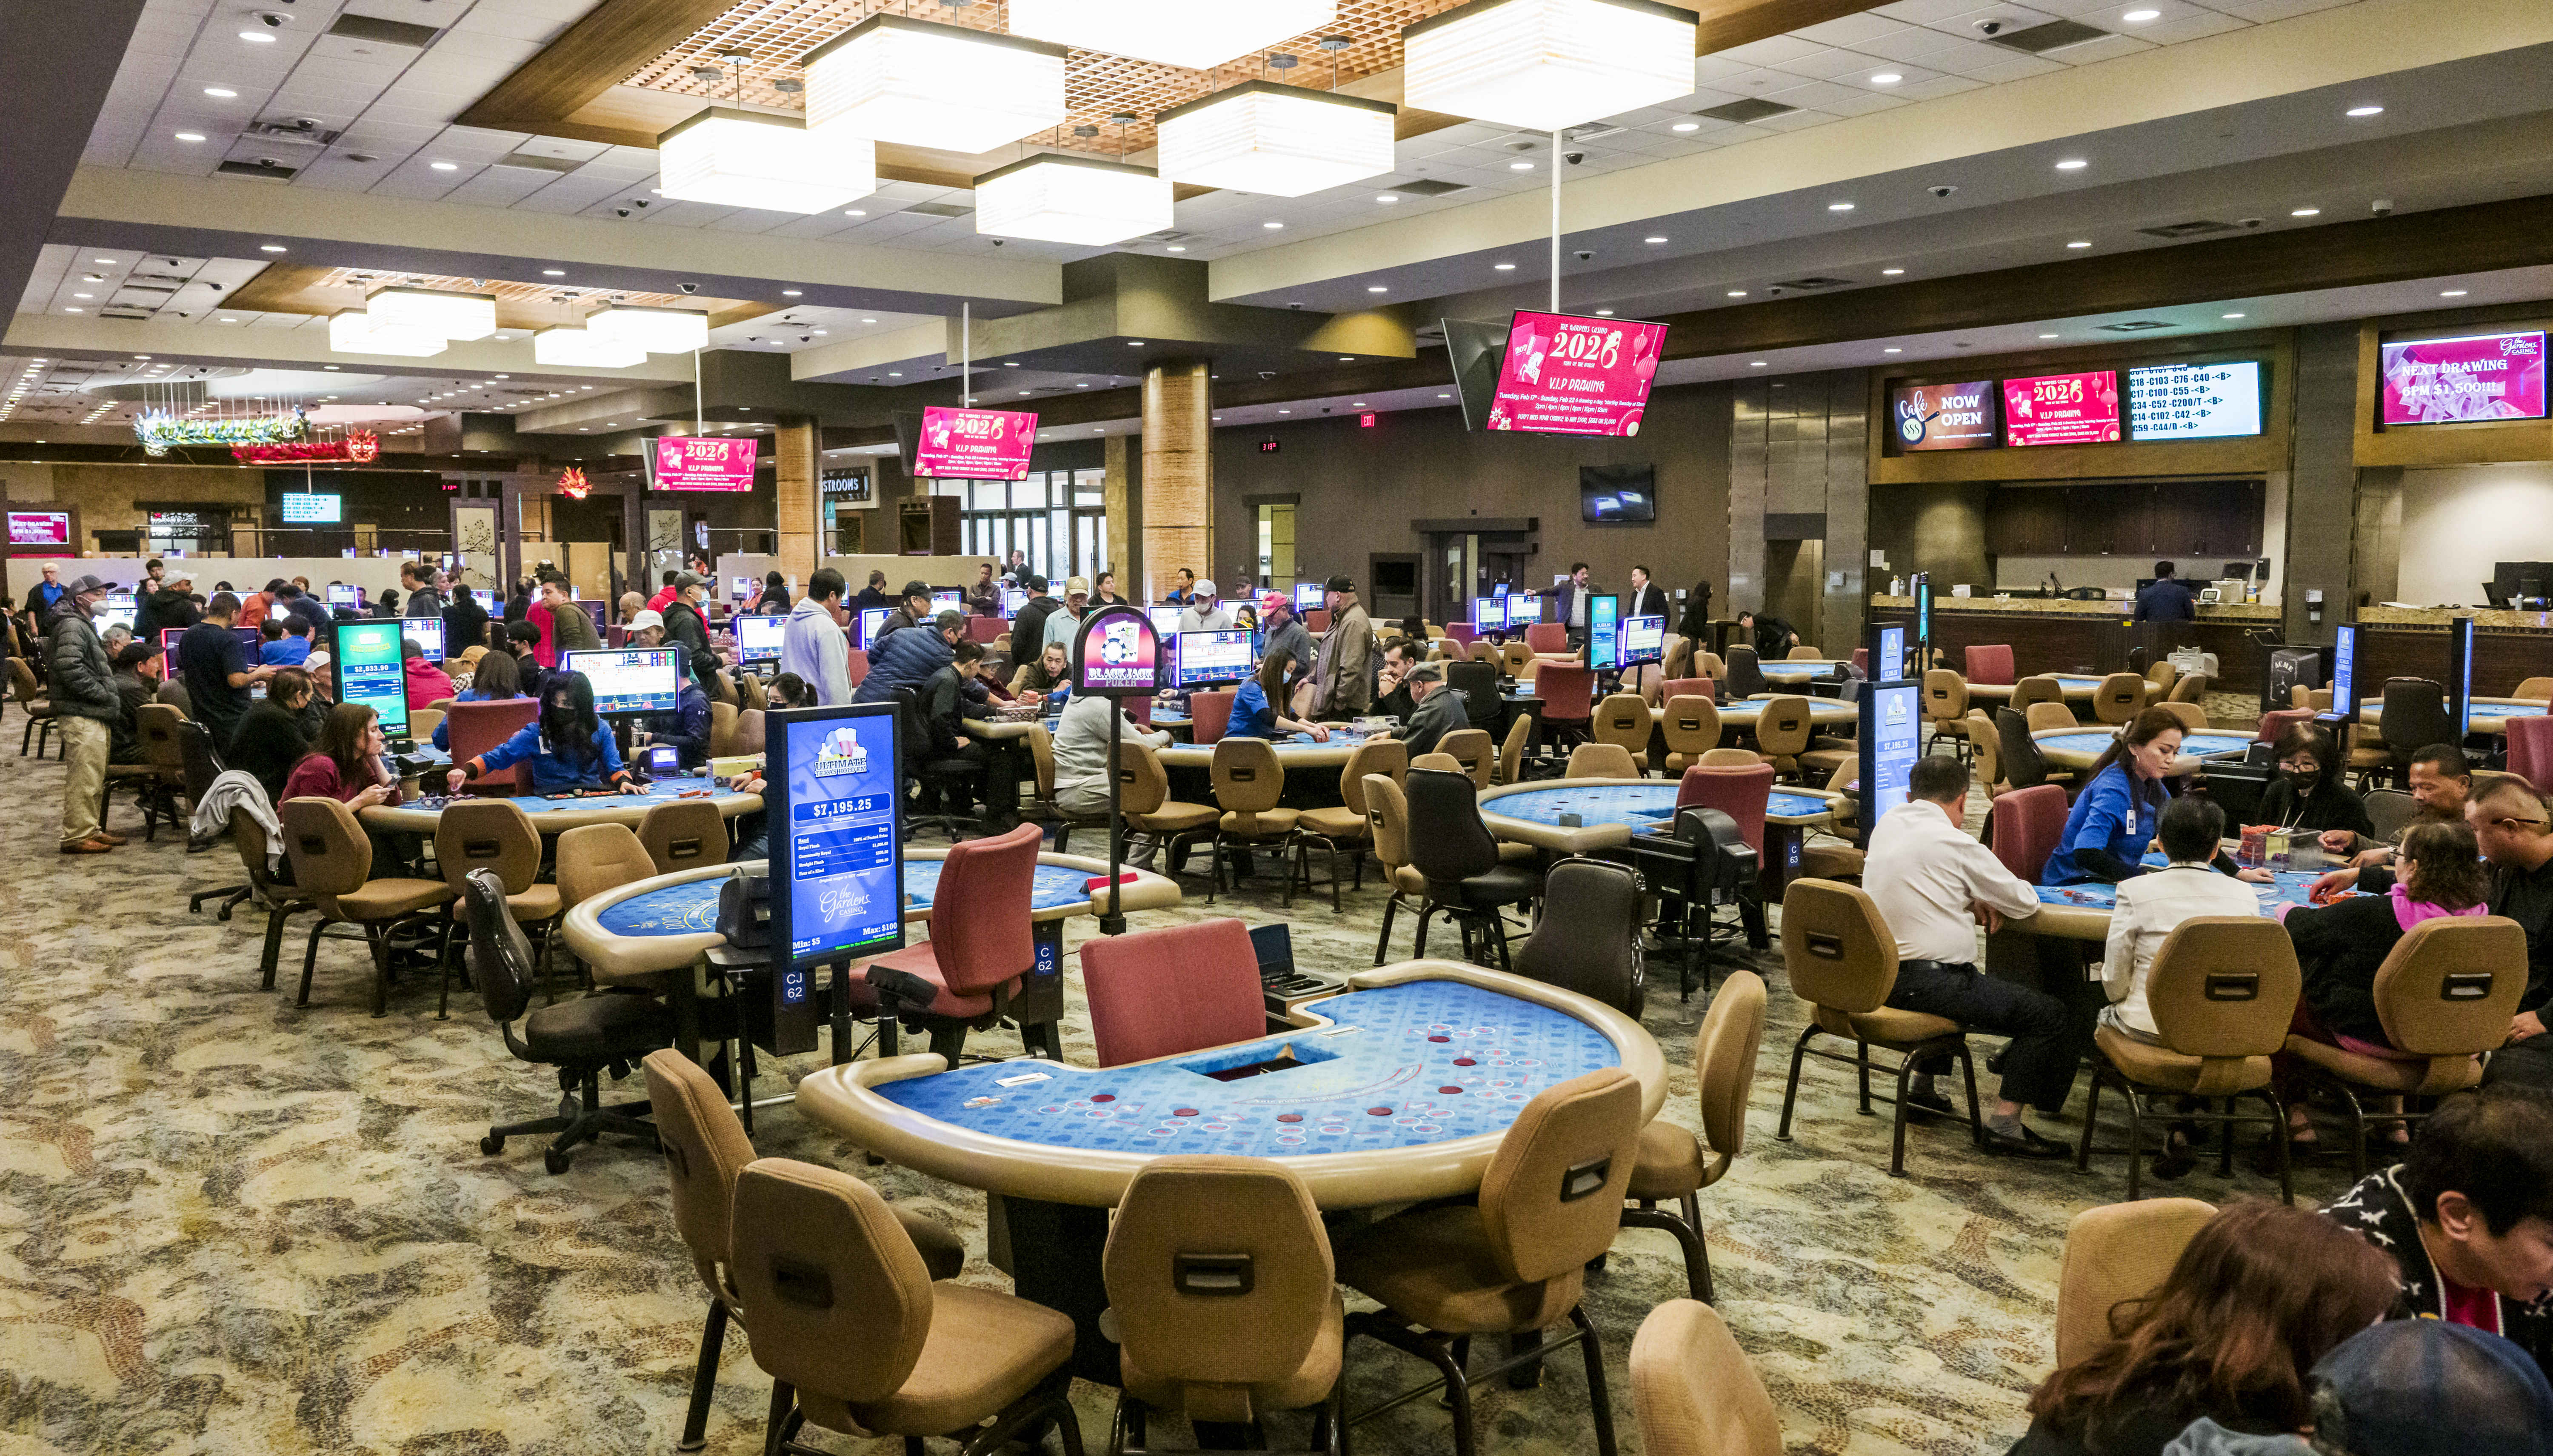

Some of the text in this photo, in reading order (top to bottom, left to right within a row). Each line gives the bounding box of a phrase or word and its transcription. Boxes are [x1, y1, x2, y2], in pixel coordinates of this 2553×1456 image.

[1569, 324, 1590, 332] GARDENS
[2514, 336, 2523, 344] the
[1549, 330, 1622, 369] 2026
[2500, 338, 2538, 356] Gardens
[2402, 359, 2508, 377] NEXT DRAWING
[1549, 377, 1605, 392] V.I.P DRAWING
[2130, 378, 2145, 387] C18
[2146, 377, 2169, 385] -C103
[2171, 375, 2189, 384] -C76
[2191, 373, 2210, 382] -C40
[1499, 392, 1519, 400] Tuesday,
[2034, 379, 2083, 403] 2026
[2131, 390, 2144, 398] C17
[2145, 388, 2168, 397] -C100
[2170, 387, 2189, 396] -C55
[2402, 385, 2430, 397] 6PM
[1900, 391, 1928, 422] Café
[1941, 394, 1980, 410] NOW
[2132, 401, 2147, 410] C34
[2149, 400, 2167, 408] -C52
[2169, 397, 2202, 407] -C200/T
[1941, 412, 1982, 427] OPEN
[2054, 409, 2081, 418] DRAWING
[2133, 413, 2146, 421] C14
[2148, 411, 2170, 420] -C102
[2172, 410, 2190, 419] -C42
[954, 417, 1005, 439] 2026
[685, 443, 728, 461] 2026
[956, 444, 997, 454] V.I.P DRAWING
[822, 478, 859, 492] STROOMS
[354, 665, 389, 673] $2,833.90
[2274, 661, 2293, 672] ACME
[1088, 668, 1154, 680] BLACKJACK
[1106, 678, 1137, 687] POKER
[815, 758, 866, 770] ULTIMATE
[814, 798, 871, 817] $7,195.25
[840, 883, 851, 899] the
[820, 891, 871, 922] Gardens
[839, 906, 863, 916] CASINO
[862, 927, 881, 936] Max:
[882, 922, 897, 932] $100
[793, 937, 820, 949] Min: $5
[1041, 948, 1049, 957] C
[1039, 960, 1052, 971] 62
[787, 973, 802, 984] CJ
[788, 987, 802, 998] 62
